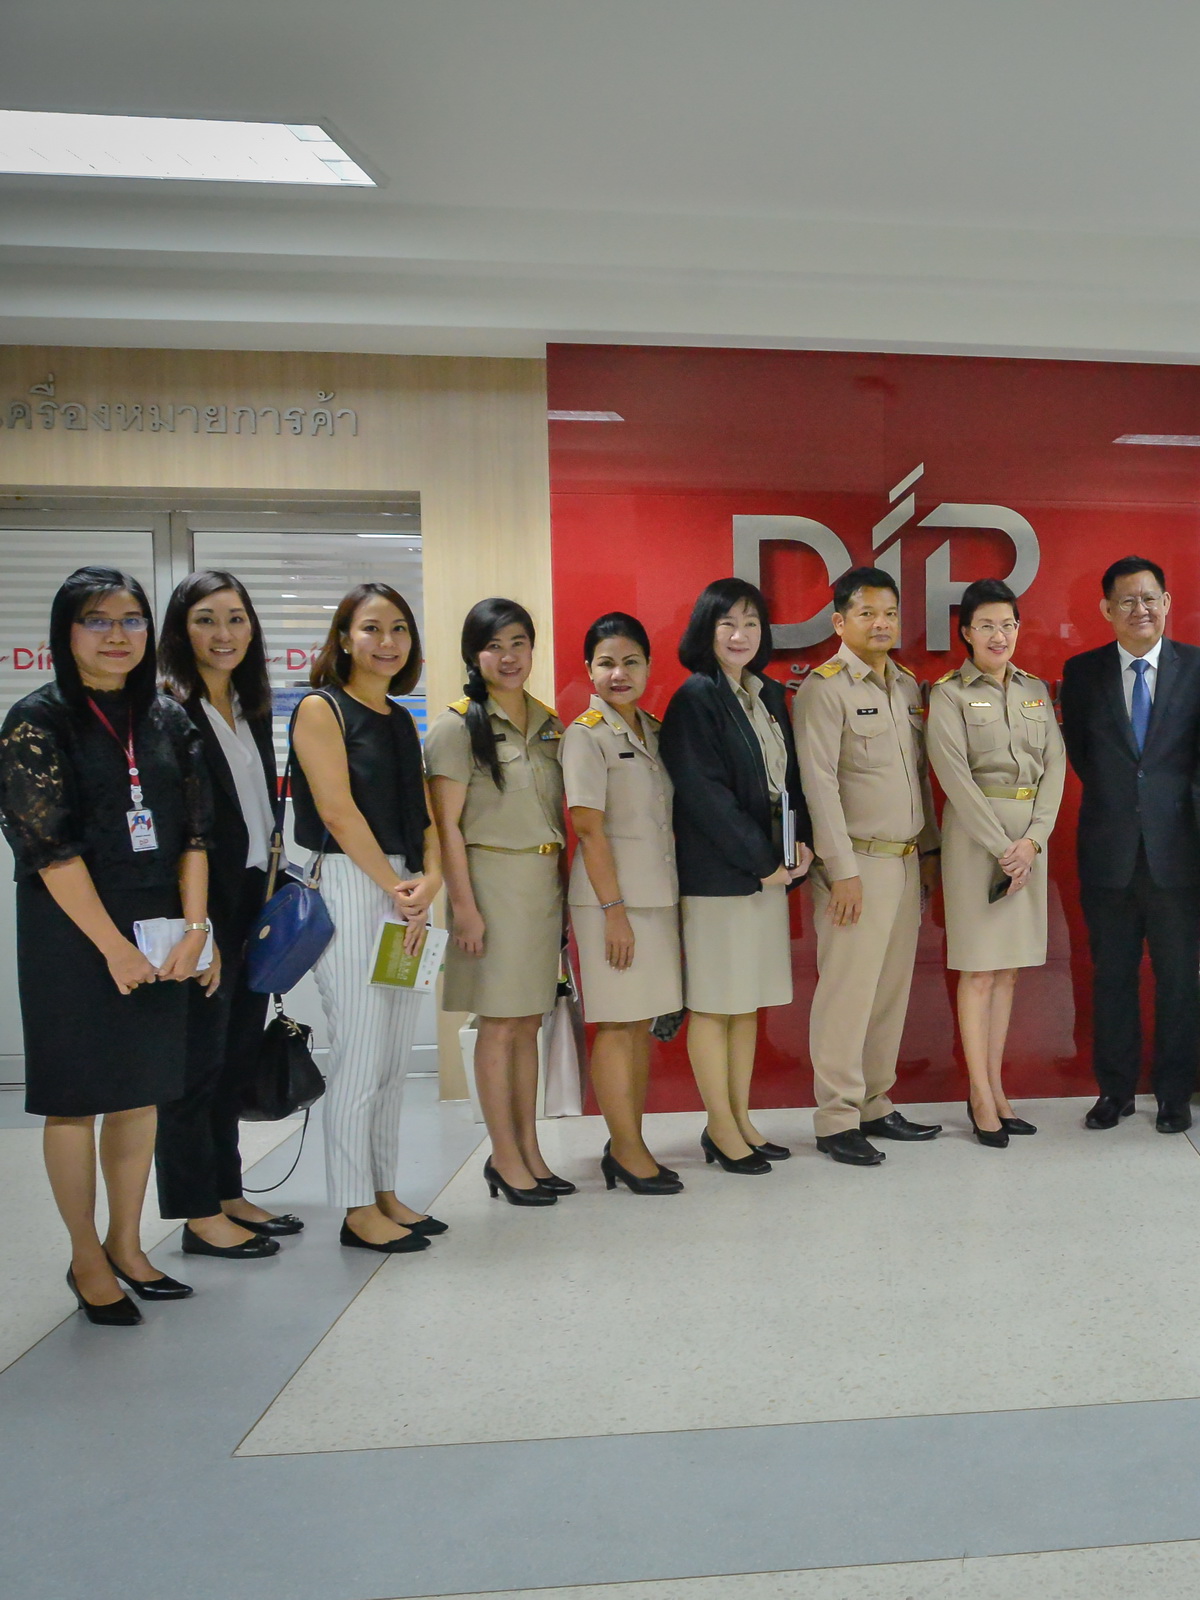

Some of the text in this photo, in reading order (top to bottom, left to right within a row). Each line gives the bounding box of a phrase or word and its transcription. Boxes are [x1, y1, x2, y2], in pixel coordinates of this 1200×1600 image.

[0, 373, 358, 436] ครื่องหมายการค้า
